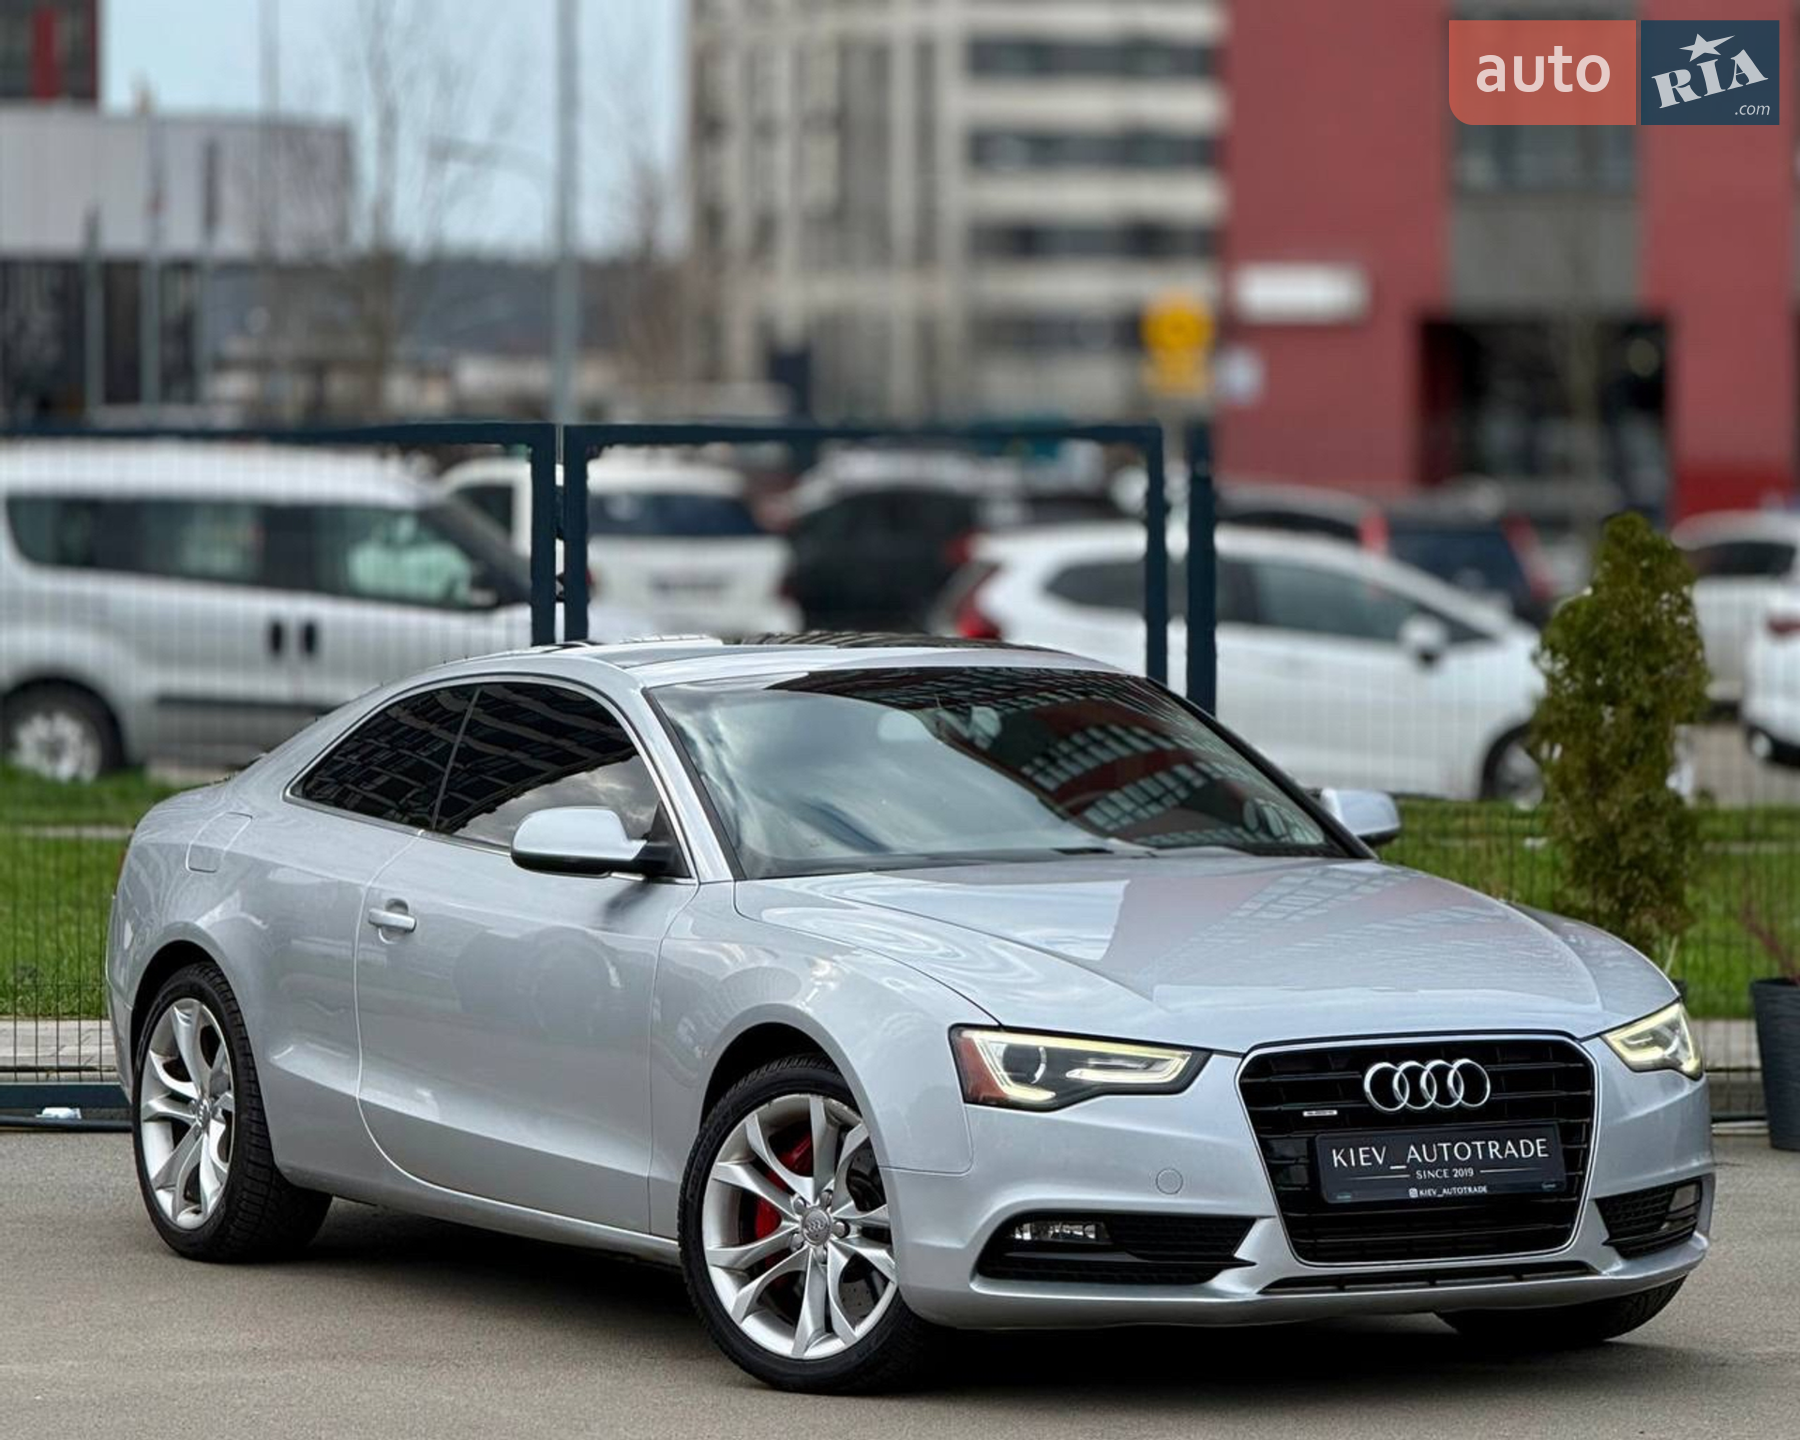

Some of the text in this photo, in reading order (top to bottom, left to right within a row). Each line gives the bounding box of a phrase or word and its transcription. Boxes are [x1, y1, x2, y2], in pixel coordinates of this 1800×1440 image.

[1332, 1138, 1549, 1169] KIEV_AUTOTRADE
[1416, 1167, 1475, 1180] SINCE 2019
[1419, 1185, 1488, 1198] KIEV_AUTOTRADE
